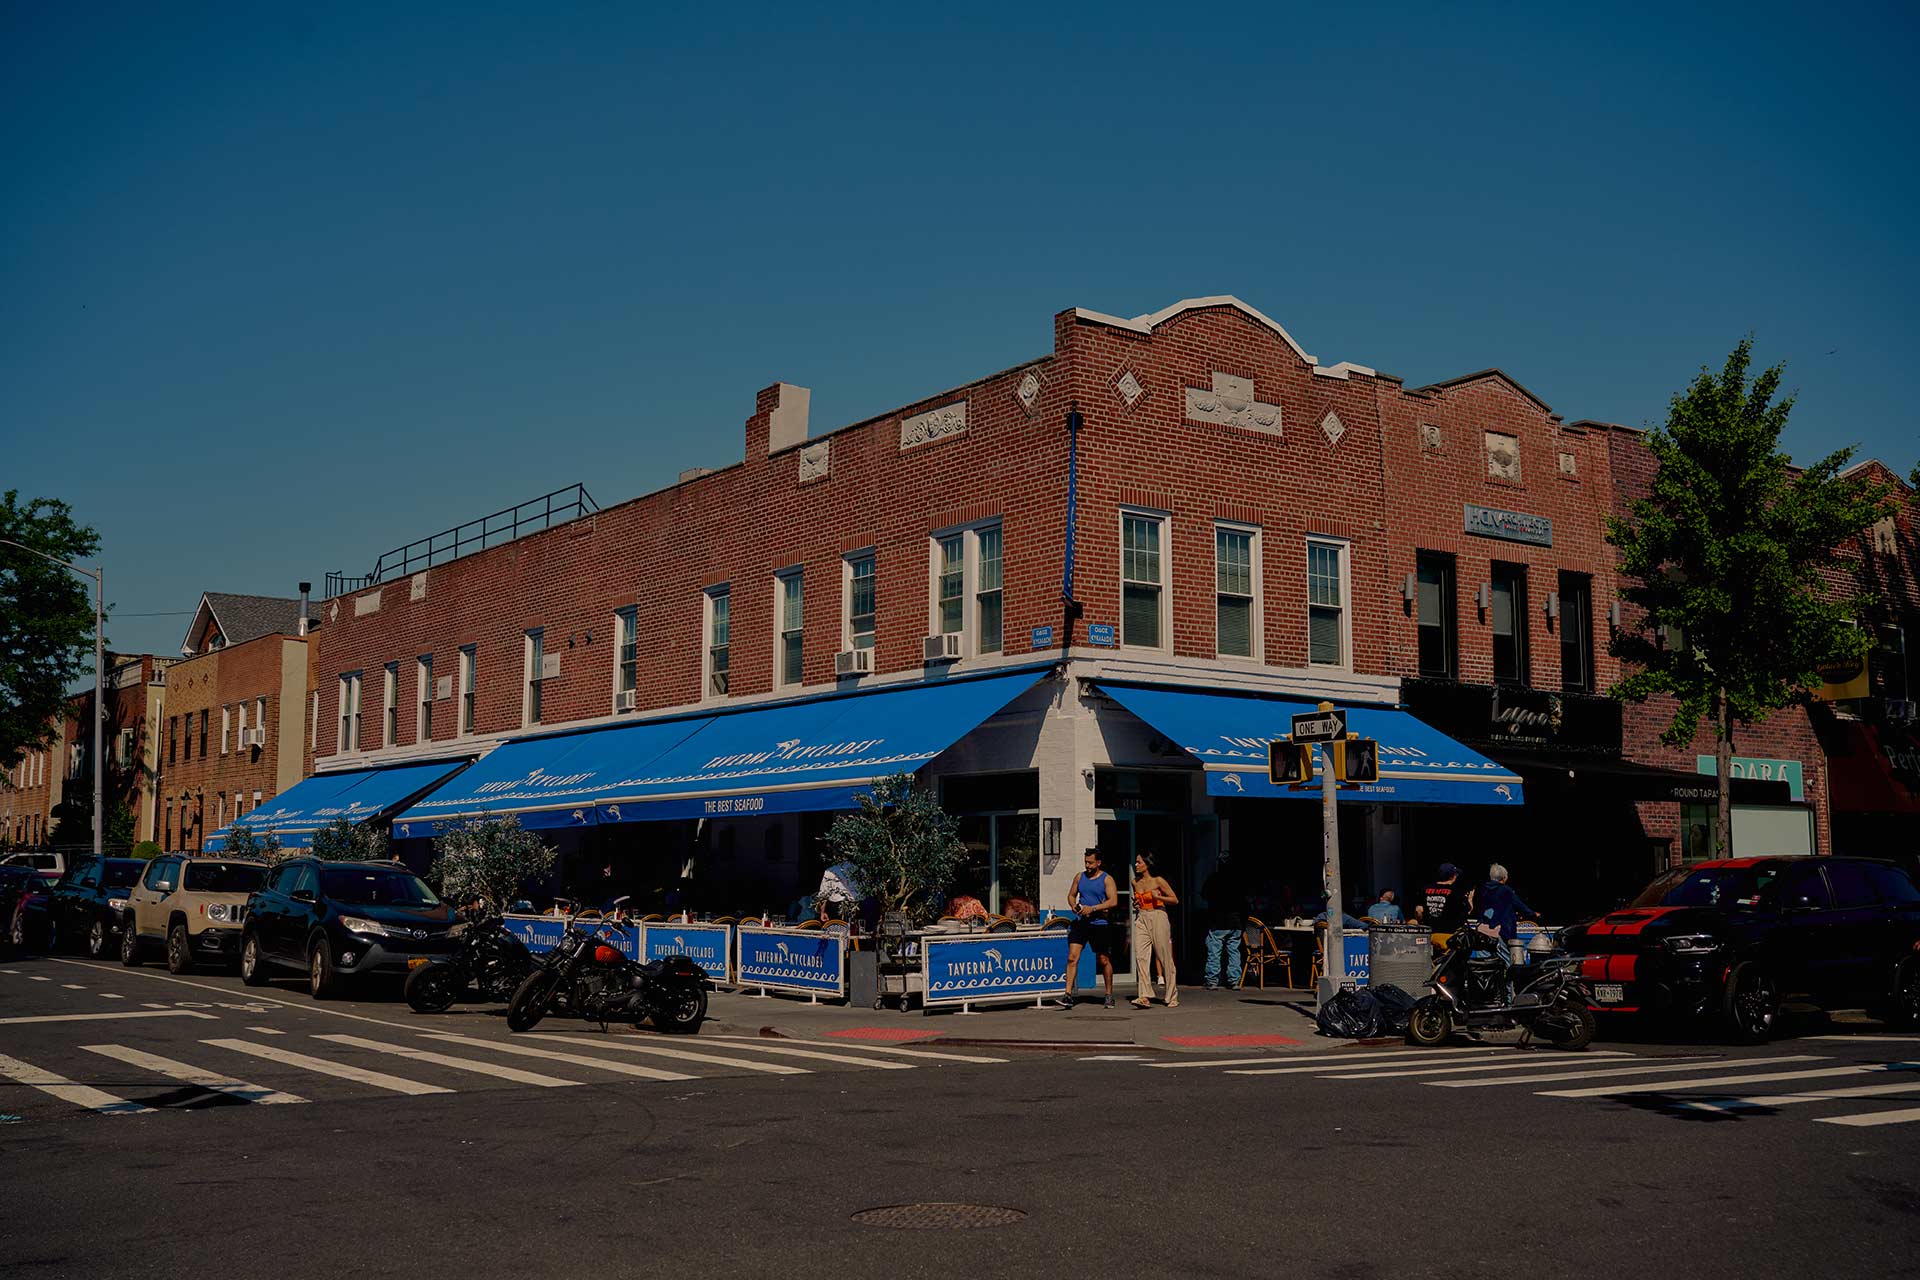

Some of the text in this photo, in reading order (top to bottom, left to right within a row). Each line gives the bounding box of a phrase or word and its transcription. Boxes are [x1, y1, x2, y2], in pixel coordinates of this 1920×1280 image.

[1300, 720, 1338, 735] ONE WAY
[701, 739, 878, 769] TAVERNA KYCLADES
[704, 798, 764, 813] THE BEST SEAFOOD
[654, 944, 715, 959] TAVERNA KYCLADES
[755, 950, 824, 968] TAVERNA KYCLADES
[947, 956, 1054, 977] TAVERNA KYCLADES
[1349, 953, 1369, 967] TAVE
